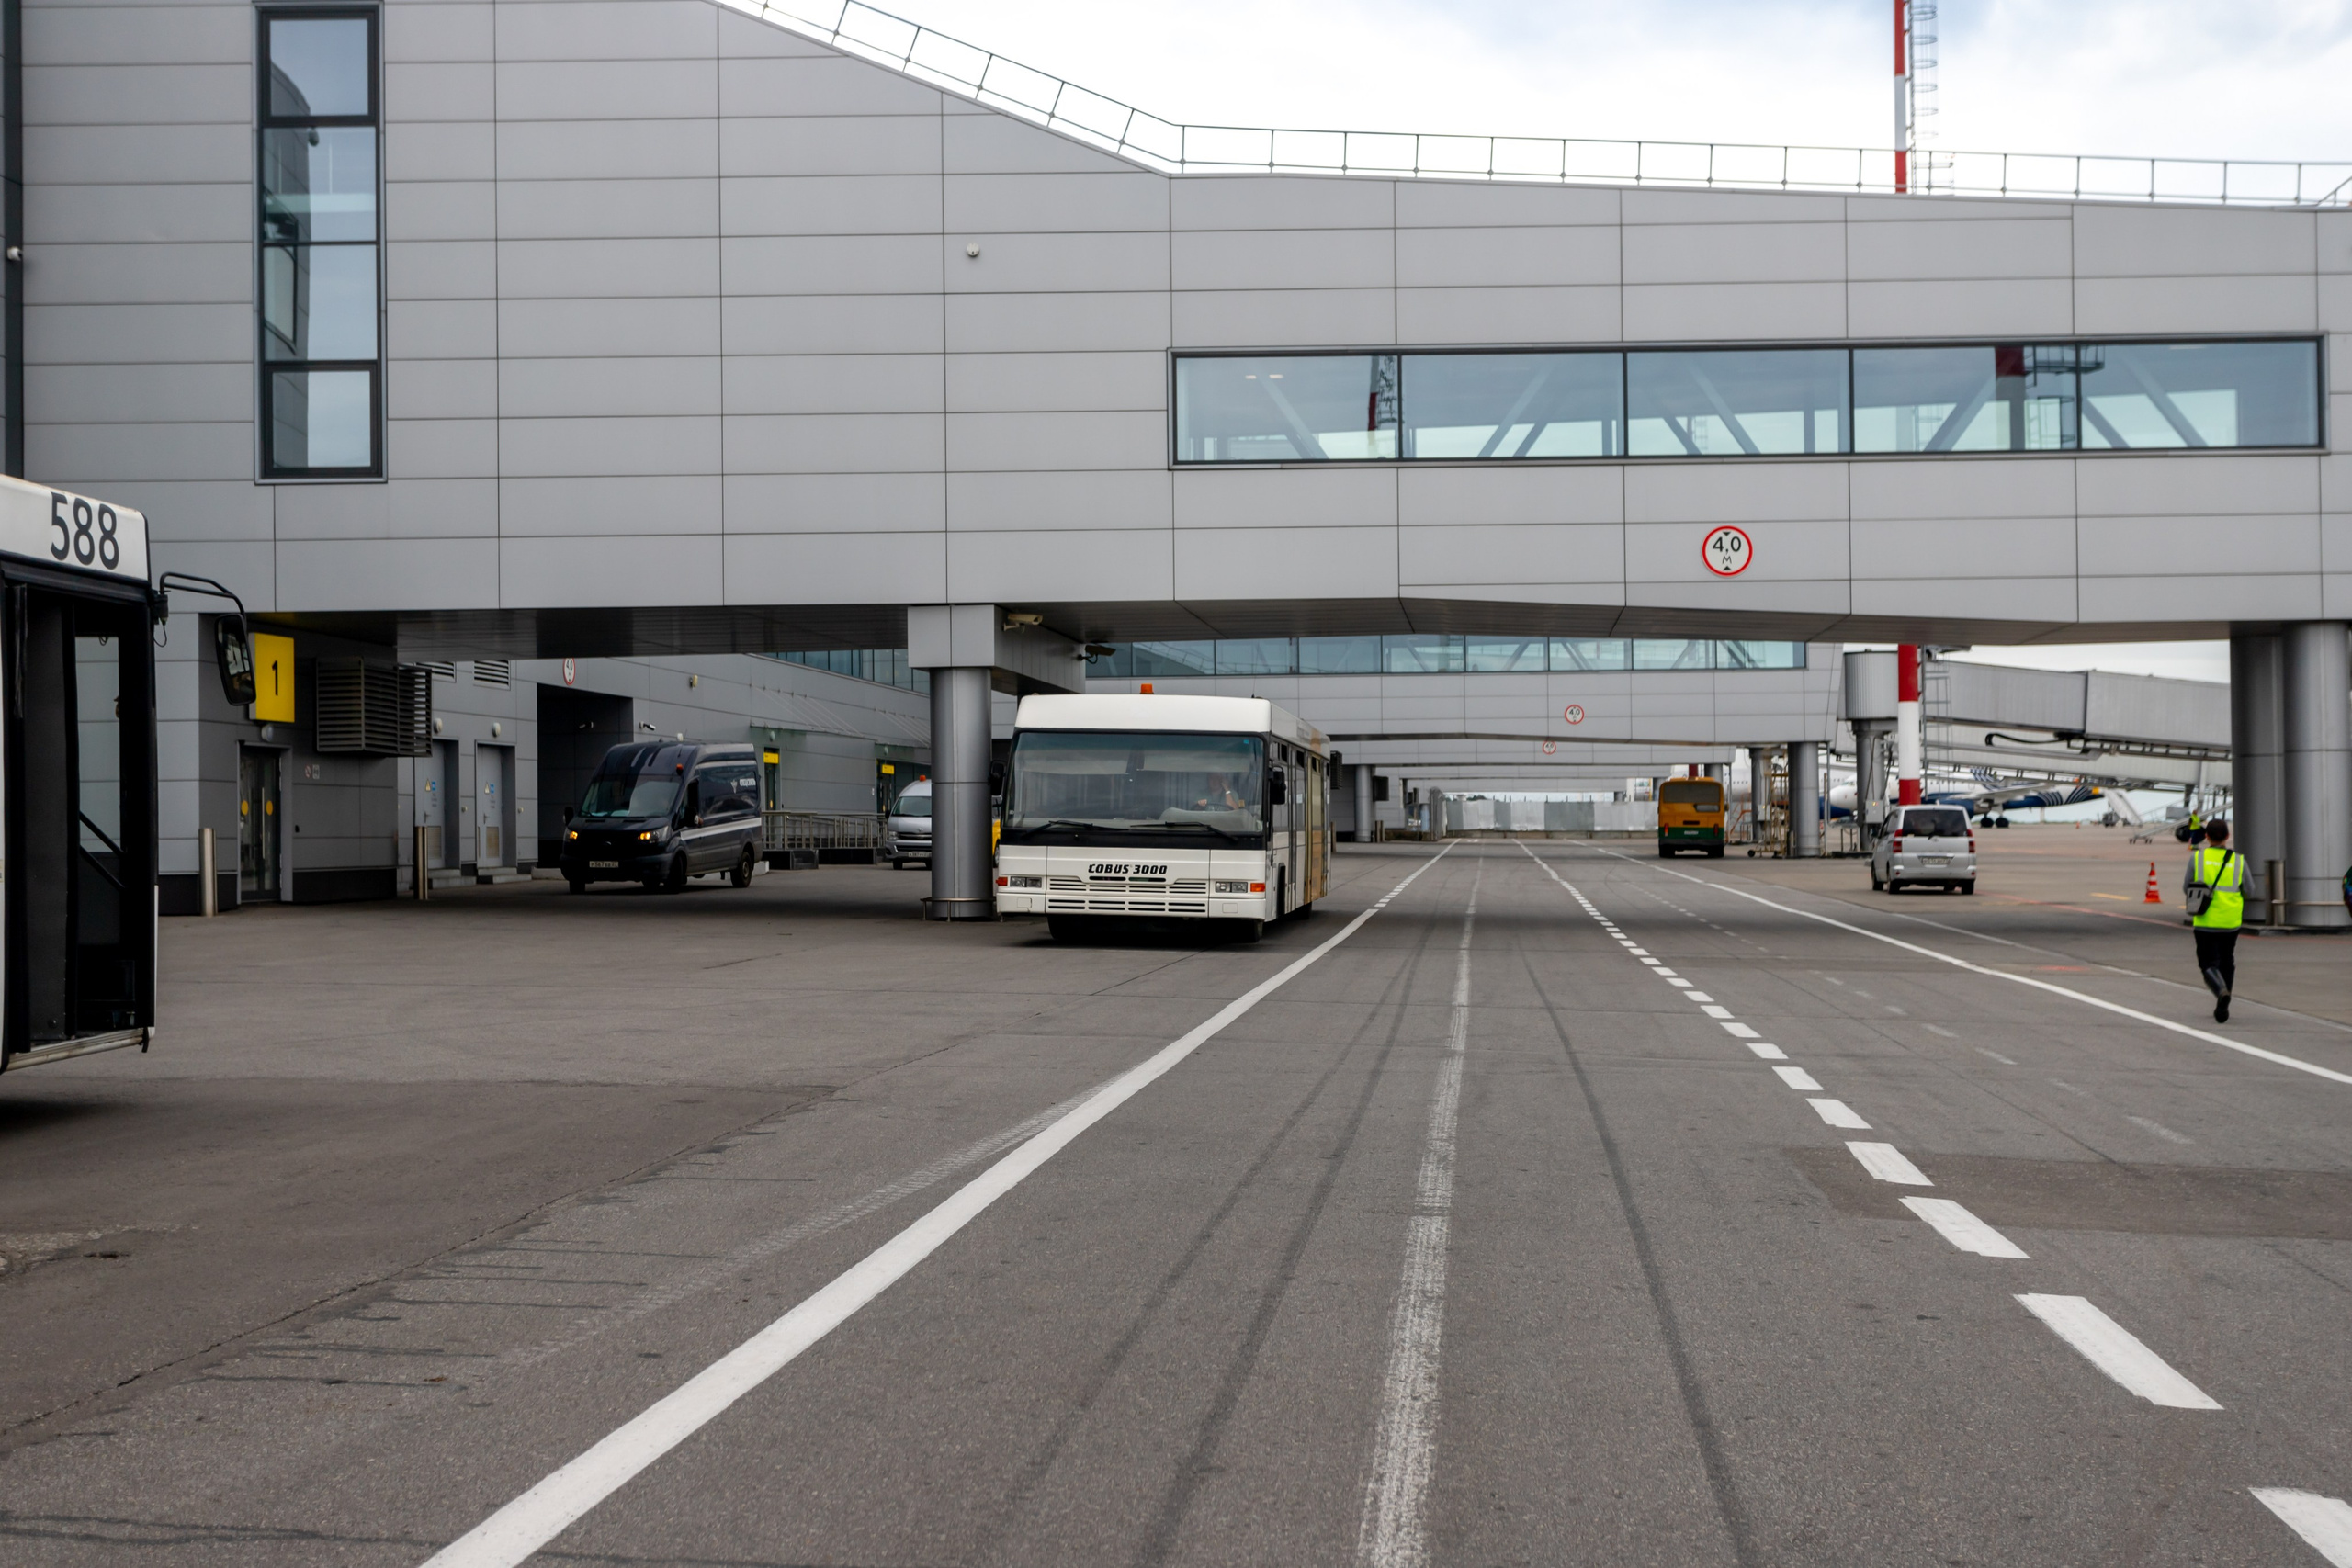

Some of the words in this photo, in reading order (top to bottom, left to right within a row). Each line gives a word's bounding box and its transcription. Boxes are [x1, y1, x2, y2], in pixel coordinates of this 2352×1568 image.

[51, 491, 119, 570] 588
[1713, 536, 1741, 555] 4,0
[272, 660, 279, 696] 1
[1088, 863, 1129, 874] COBUS
[1133, 864, 1168, 874] 3000
